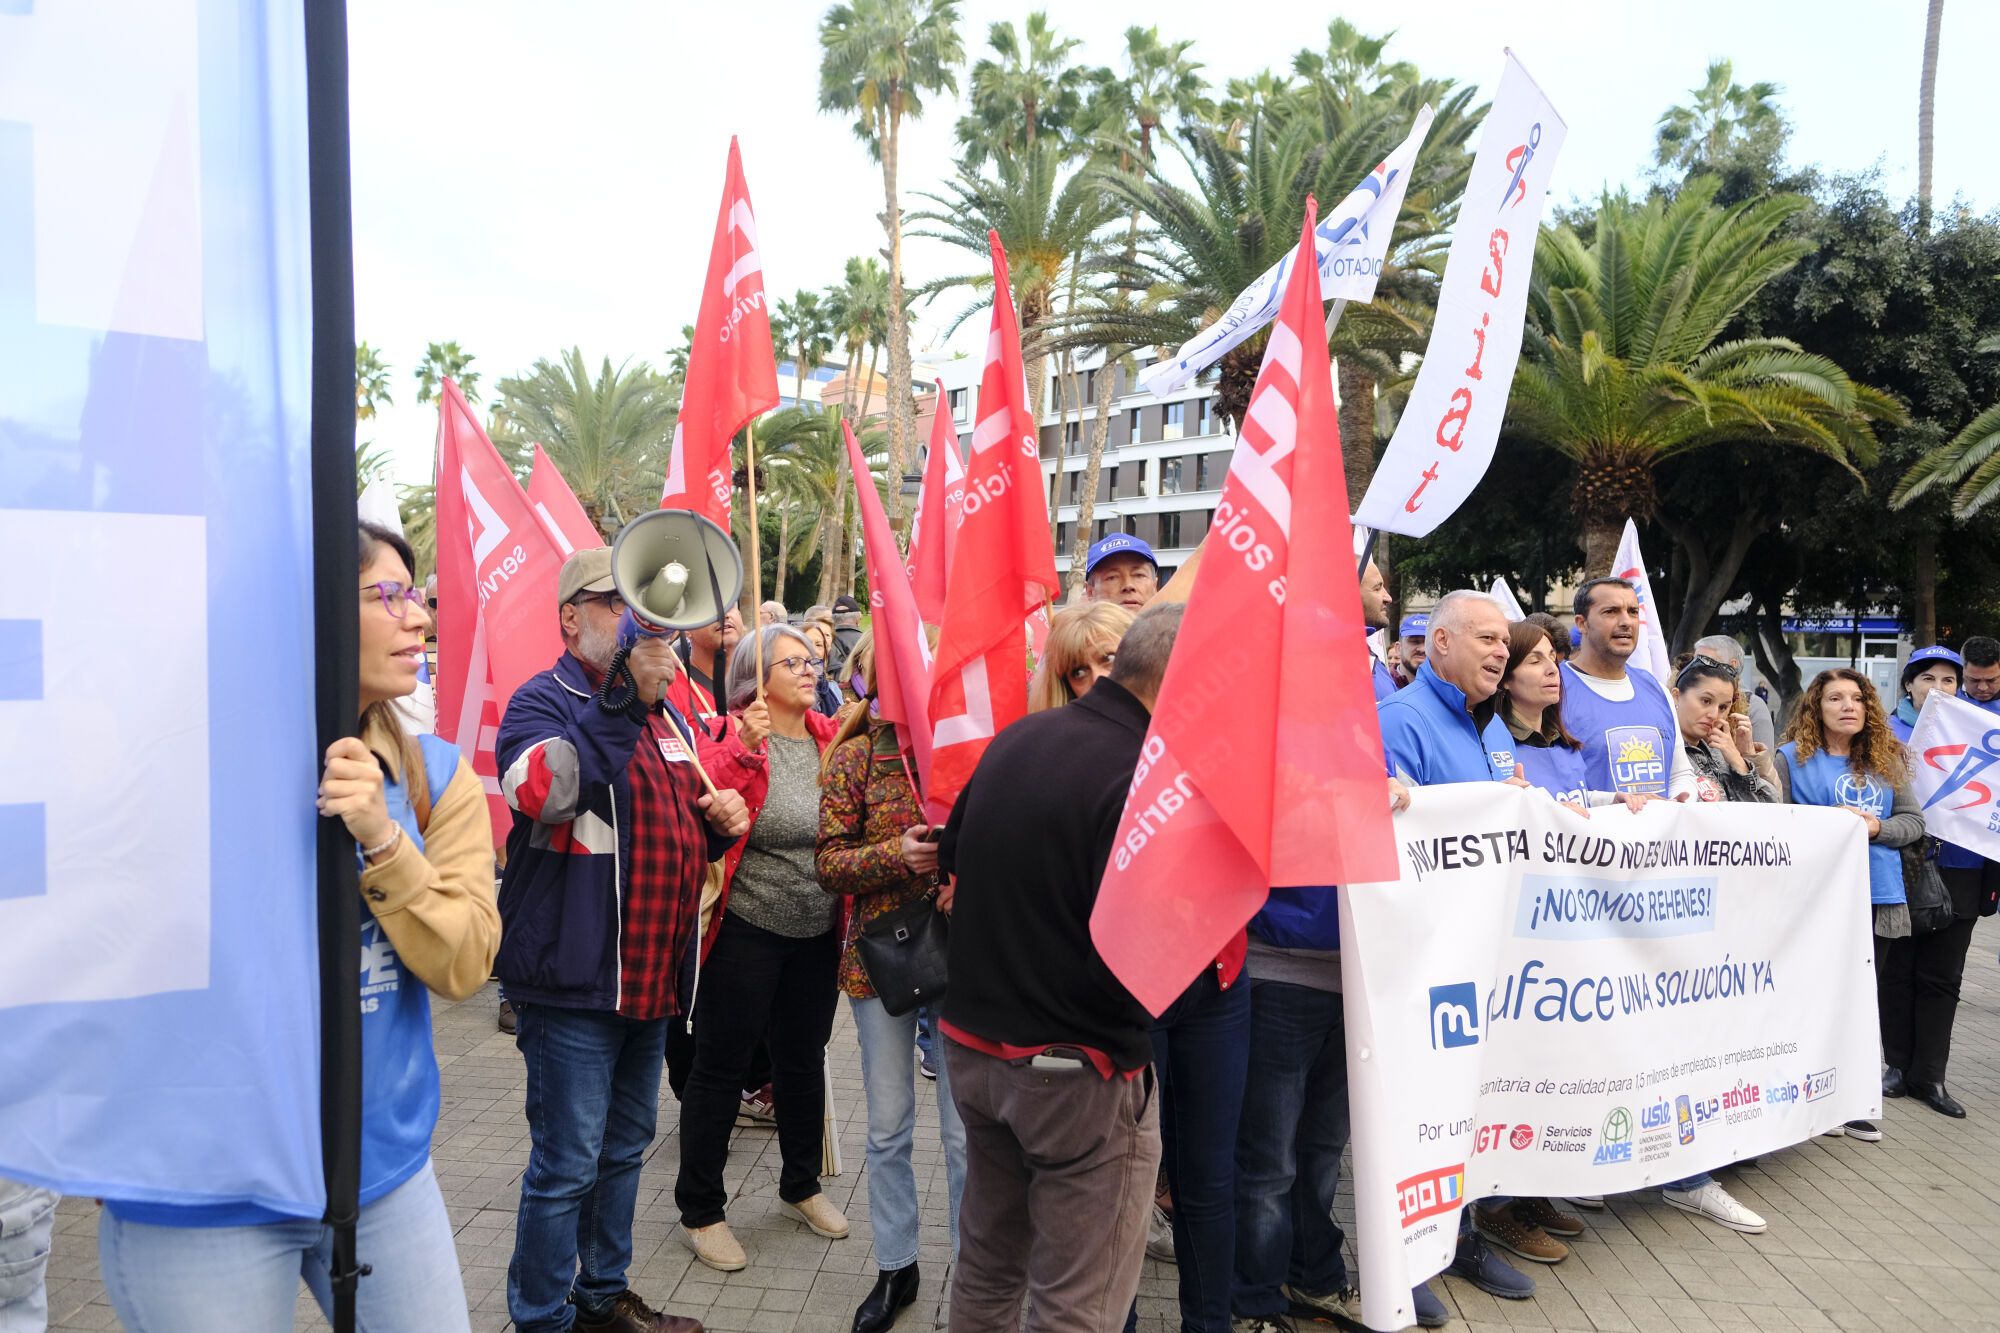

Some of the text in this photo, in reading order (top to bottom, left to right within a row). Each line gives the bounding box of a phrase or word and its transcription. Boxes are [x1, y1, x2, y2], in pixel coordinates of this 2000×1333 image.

[1616, 761, 1663, 783] UFP
[1543, 832, 1616, 869] SALUD
[1620, 840, 1645, 869] NO
[1644, 840, 1661, 868] ES
[1661, 839, 1688, 868] UNA
[1694, 836, 1792, 867] MERCANCÍA!
[1648, 887, 1711, 923] REHENES!
[1486, 960, 1614, 1042] uface
[1618, 973, 1654, 1015] UNA
[1656, 953, 1746, 1008] SOLUCIÓN
[1752, 960, 1776, 994] YA
[1419, 1124, 1444, 1143] Por
[1449, 1117, 1473, 1137] una
[1480, 1077, 1530, 1097] sanitaria
[1535, 1079, 1556, 1095] de
[1559, 1077, 1606, 1095] calidad
[1607, 1078, 1632, 1096] para
[1680, 1055, 1717, 1076] empleados
[1724, 1047, 1764, 1066] empleadas
[1766, 1041, 1798, 1060] públicos
[1766, 1081, 1799, 1104] acaip
[1814, 1074, 1835, 1094] SIAT
[1725, 1105, 1762, 1126] federación
[1546, 1126, 1592, 1138] Servicios
[1542, 1140, 1587, 1152] Públicos
[1594, 1141, 1632, 1162] ANPE
